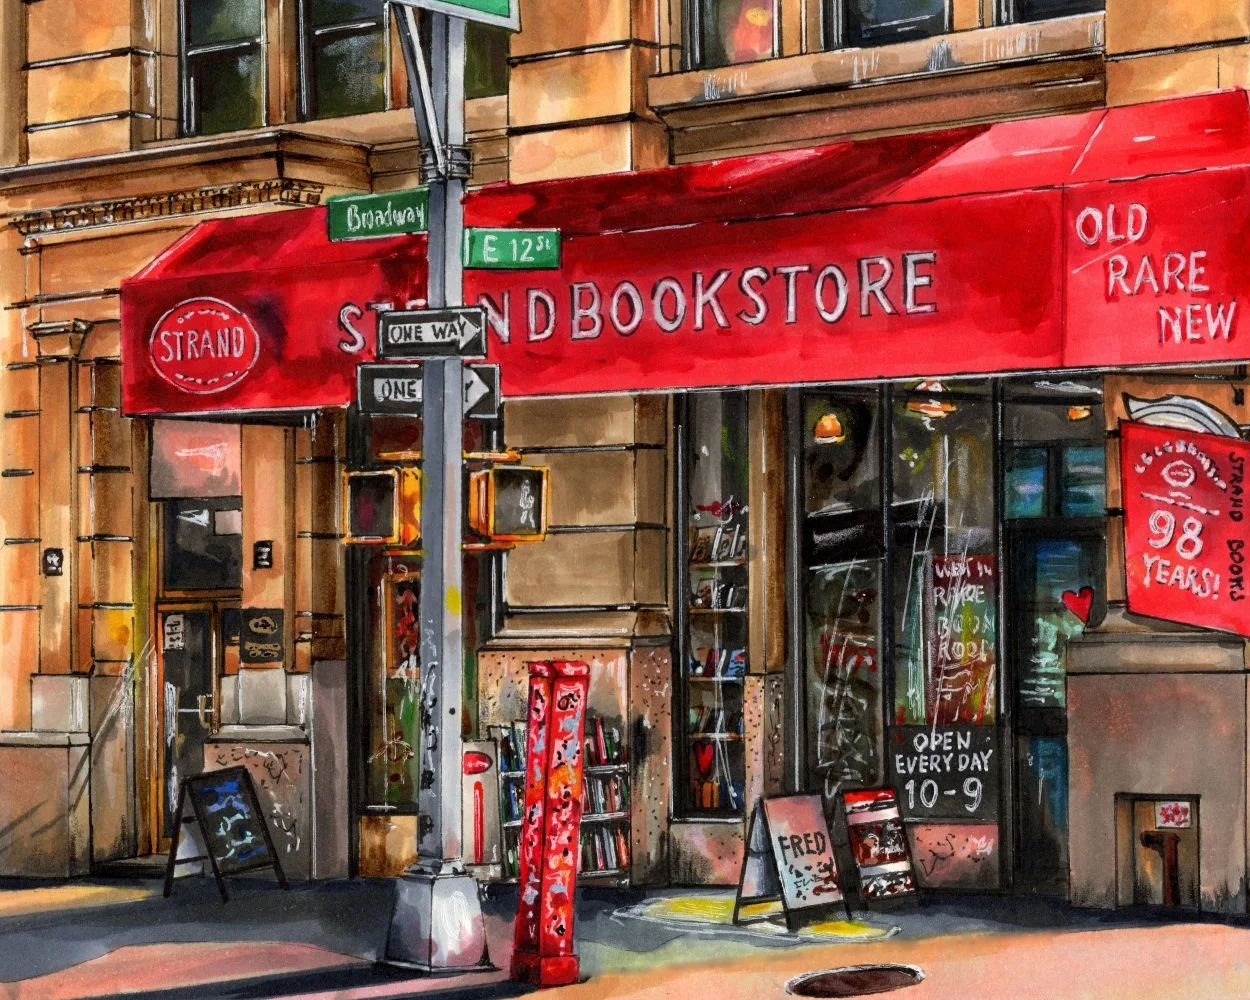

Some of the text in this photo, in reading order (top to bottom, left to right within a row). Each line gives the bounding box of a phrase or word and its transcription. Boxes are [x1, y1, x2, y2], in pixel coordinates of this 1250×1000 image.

[346, 201, 425, 233] Broadway
[1075, 203, 1149, 245] OLD
[483, 234, 500, 264] E
[510, 238, 535, 262] 12
[1108, 250, 1210, 297] RARE
[568, 250, 938, 342] BOOKSTORE
[390, 316, 466, 342] ONE WAY
[1158, 301, 1237, 343] NEW
[159, 325, 245, 363] STRAND
[381, 379, 416, 401] ONE
[1226, 451, 1245, 523] STRAND
[1148, 508, 1204, 561] 98
[1142, 552, 1221, 600] YEARS!
[1226, 538, 1246, 603] BOOKS
[895, 749, 993, 774] EVERY DAY
[912, 732, 972, 752] OPEN
[778, 830, 826, 866] FRED
